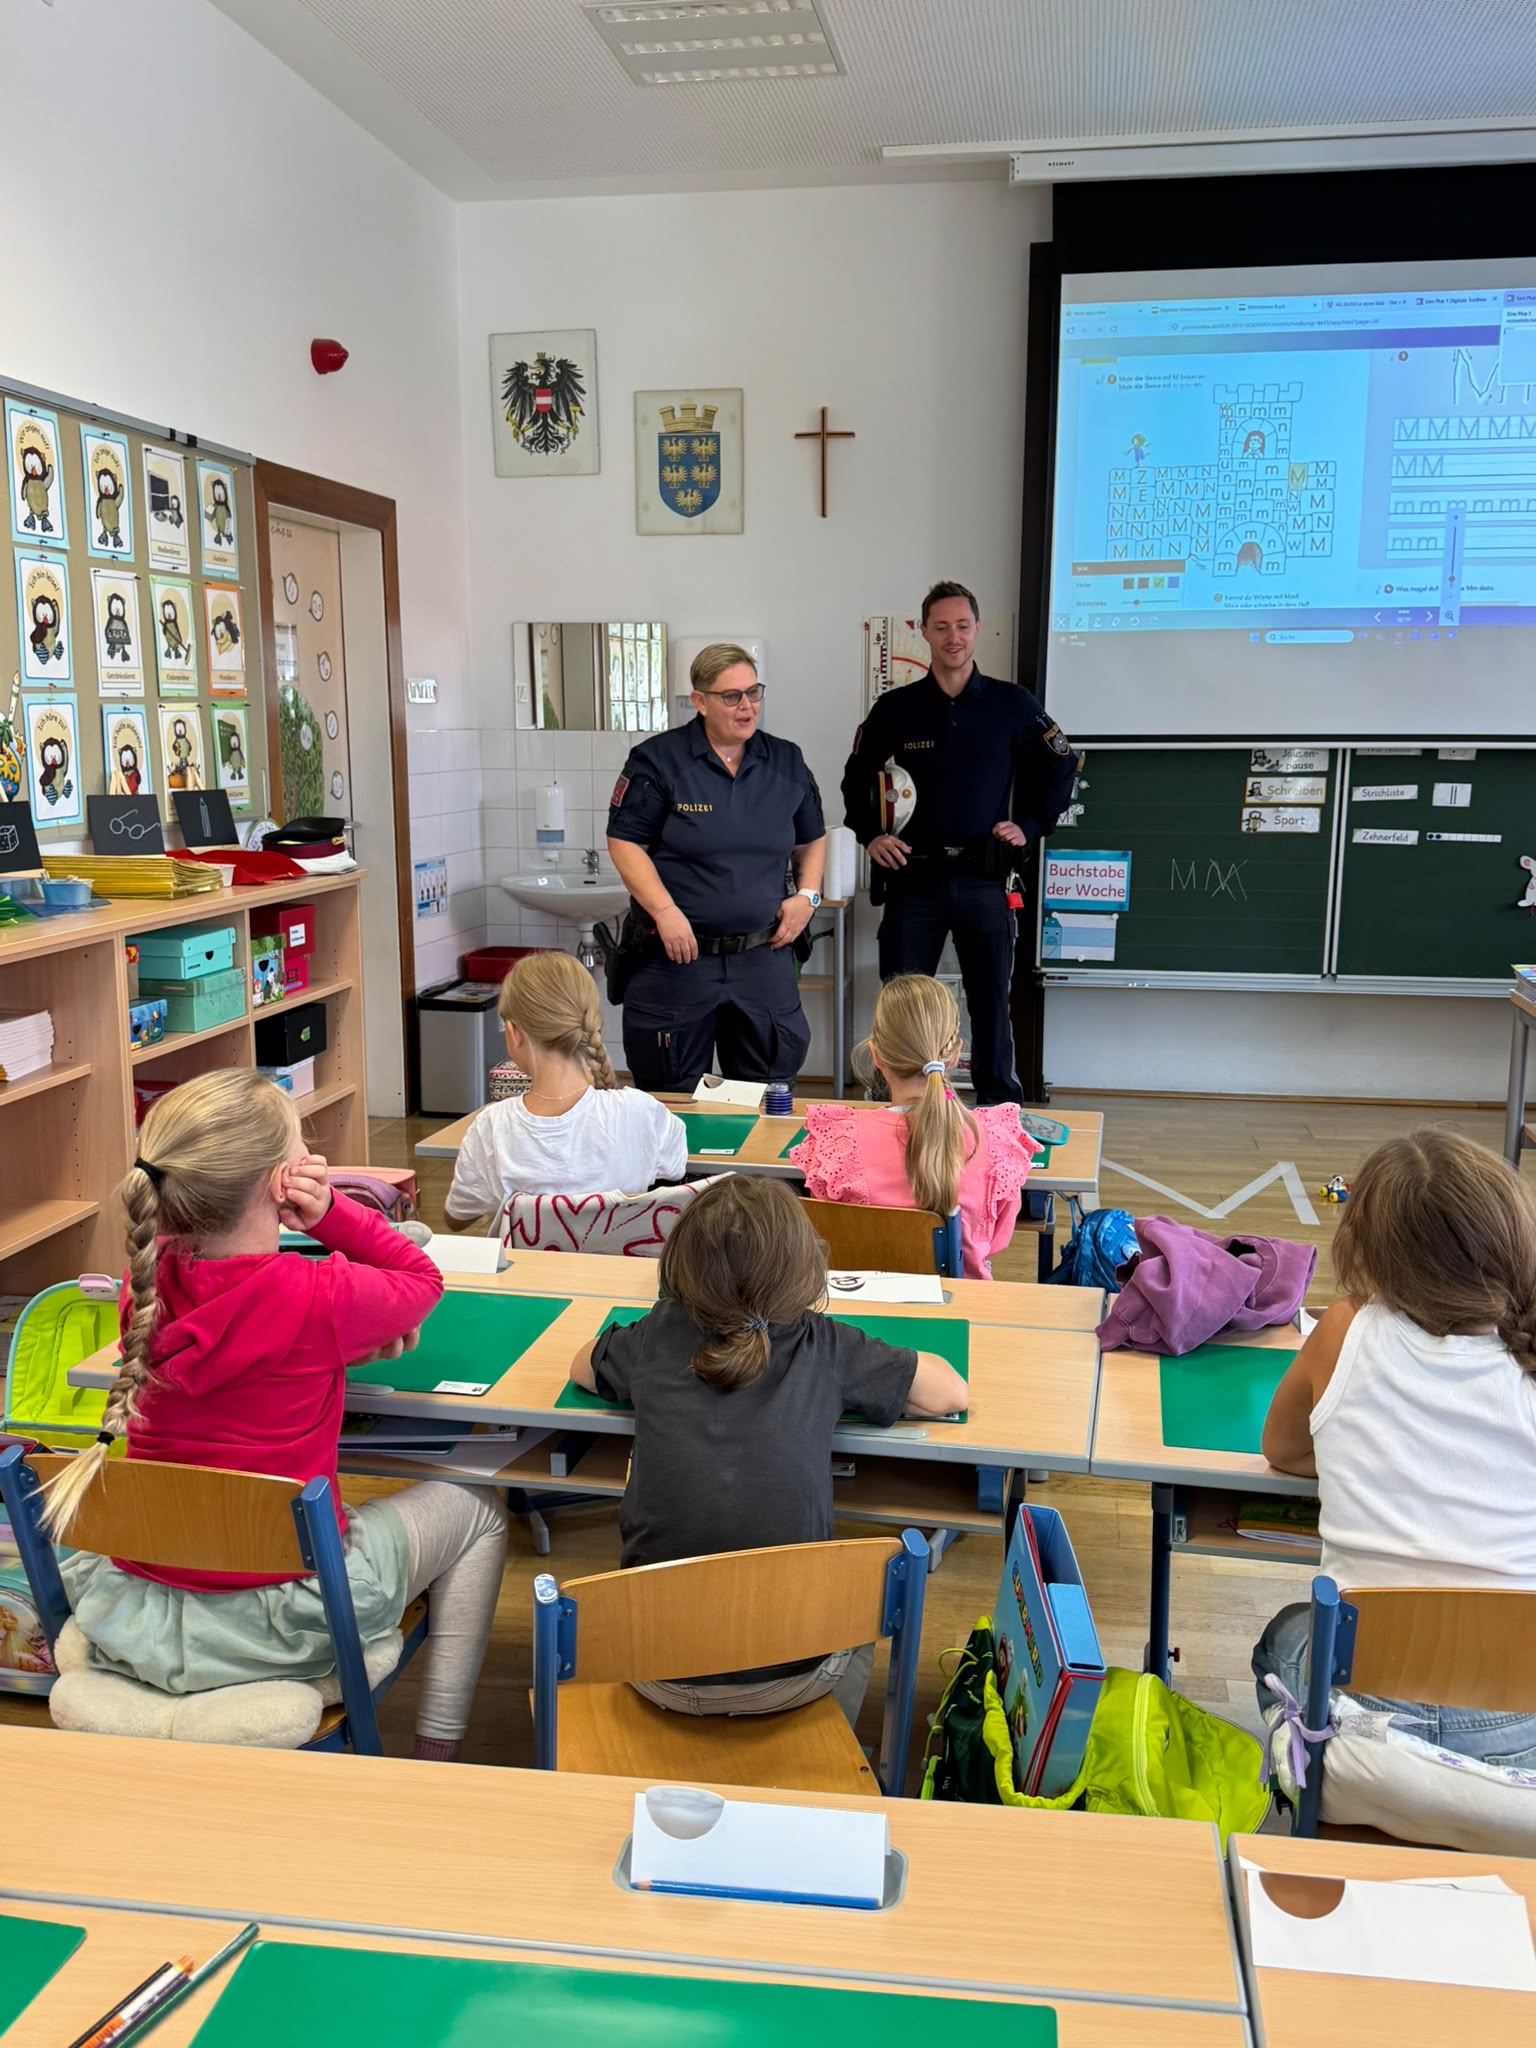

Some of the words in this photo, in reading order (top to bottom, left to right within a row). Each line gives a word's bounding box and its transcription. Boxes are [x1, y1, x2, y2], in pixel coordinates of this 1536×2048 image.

[1238, 407, 1246, 416] n
[1253, 407, 1267, 416] m
[1274, 406, 1287, 416] m
[1224, 418, 1237, 428] m
[1278, 422, 1288, 432] n
[1398, 417, 1419, 440] M
[1428, 416, 1450, 440] M
[1458, 416, 1480, 440] M
[1489, 416, 1510, 439] M
[1220, 448, 1230, 456] m
[1221, 460, 1230, 469] u
[1315, 462, 1328, 474] M
[1396, 455, 1417, 476] M
[1422, 455, 1444, 476] M
[1114, 470, 1125, 480] M
[1136, 470, 1148, 484] Z
[1158, 468, 1168, 478] M
[1178, 467, 1188, 478] M
[1201, 466, 1212, 476] N
[1265, 465, 1279, 475] m
[1291, 468, 1306, 482] M
[1224, 474, 1232, 483] n
[1238, 478, 1252, 488] m
[1316, 478, 1327, 488] M
[1113, 486, 1126, 500] M
[1139, 489, 1147, 502] E
[1161, 482, 1175, 495] M
[1185, 482, 1198, 495] M
[1205, 482, 1216, 492] N
[1222, 491, 1231, 500] u
[1256, 487, 1264, 496] n
[1270, 488, 1283, 496] m
[1289, 492, 1298, 500] N
[1240, 500, 1248, 508] n
[1310, 494, 1326, 509] M
[1394, 500, 1414, 513] m
[1421, 500, 1440, 512] m
[1473, 500, 1494, 512] m
[1500, 499, 1520, 512] m
[1112, 505, 1124, 518] N
[1133, 507, 1146, 520] M
[1173, 500, 1186, 514] N
[1196, 504, 1210, 518] M
[1220, 506, 1232, 516] m
[1256, 509, 1269, 518] m
[1110, 524, 1123, 537] M
[1130, 523, 1144, 537] N
[1152, 524, 1164, 536] N
[1172, 518, 1188, 532] M
[1197, 522, 1209, 536] N
[1292, 517, 1306, 530] M
[1316, 515, 1330, 528] N
[1245, 530, 1258, 538] m
[1113, 544, 1128, 558] M
[1141, 544, 1154, 557] M
[1168, 542, 1182, 556] N
[1195, 538, 1210, 552] M
[1225, 540, 1234, 548] n
[1268, 539, 1276, 548] n
[1310, 537, 1326, 552] M
[1392, 538, 1412, 550] m
[1418, 537, 1438, 550] m
[1218, 560, 1232, 571] m
[1266, 561, 1280, 571] m
[1361, 788, 1405, 798] Strichliste
[676, 804, 712, 812] POLIZEI
[1274, 816, 1306, 828] Sport
[1362, 832, 1409, 842] Zehnerfeld
[1049, 864, 1126, 879] Buchstabe
[1170, 858, 1196, 890] M
[1046, 882, 1071, 896] der
[1076, 883, 1126, 898] Woche
